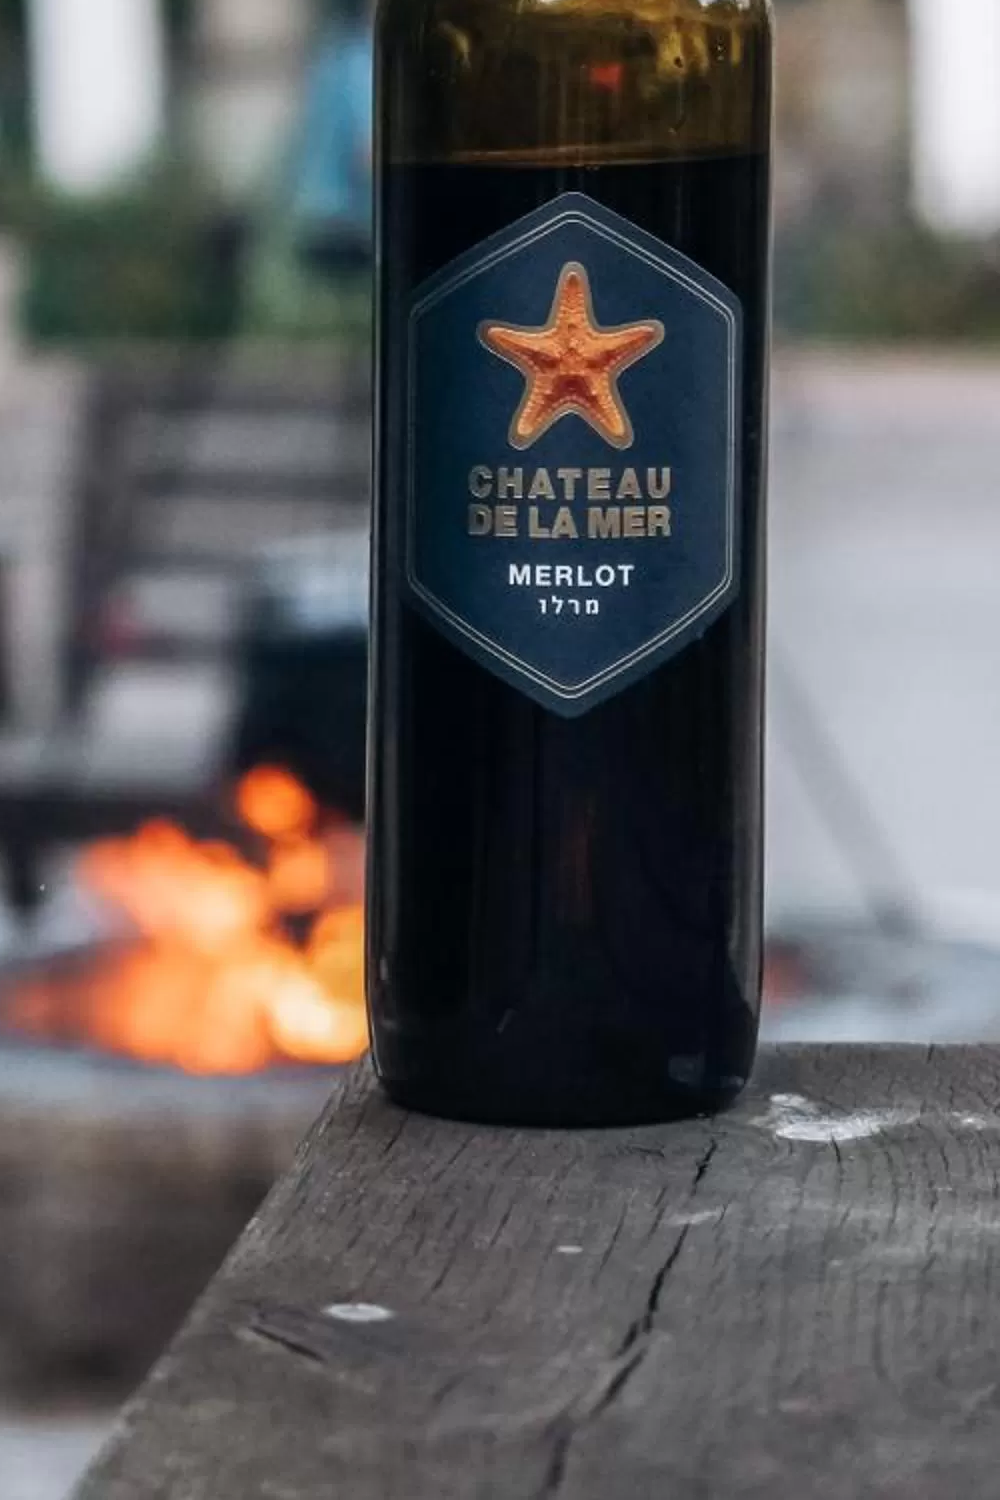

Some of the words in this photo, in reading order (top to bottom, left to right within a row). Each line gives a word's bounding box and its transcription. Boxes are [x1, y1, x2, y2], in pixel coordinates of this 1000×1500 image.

[467, 464, 673, 500] CHATEAU
[467, 503, 519, 537] DE
[528, 506, 579, 539] LA
[587, 505, 673, 538] MER
[508, 563, 635, 587] MERLOT
[538, 595, 600, 616] מרלו
